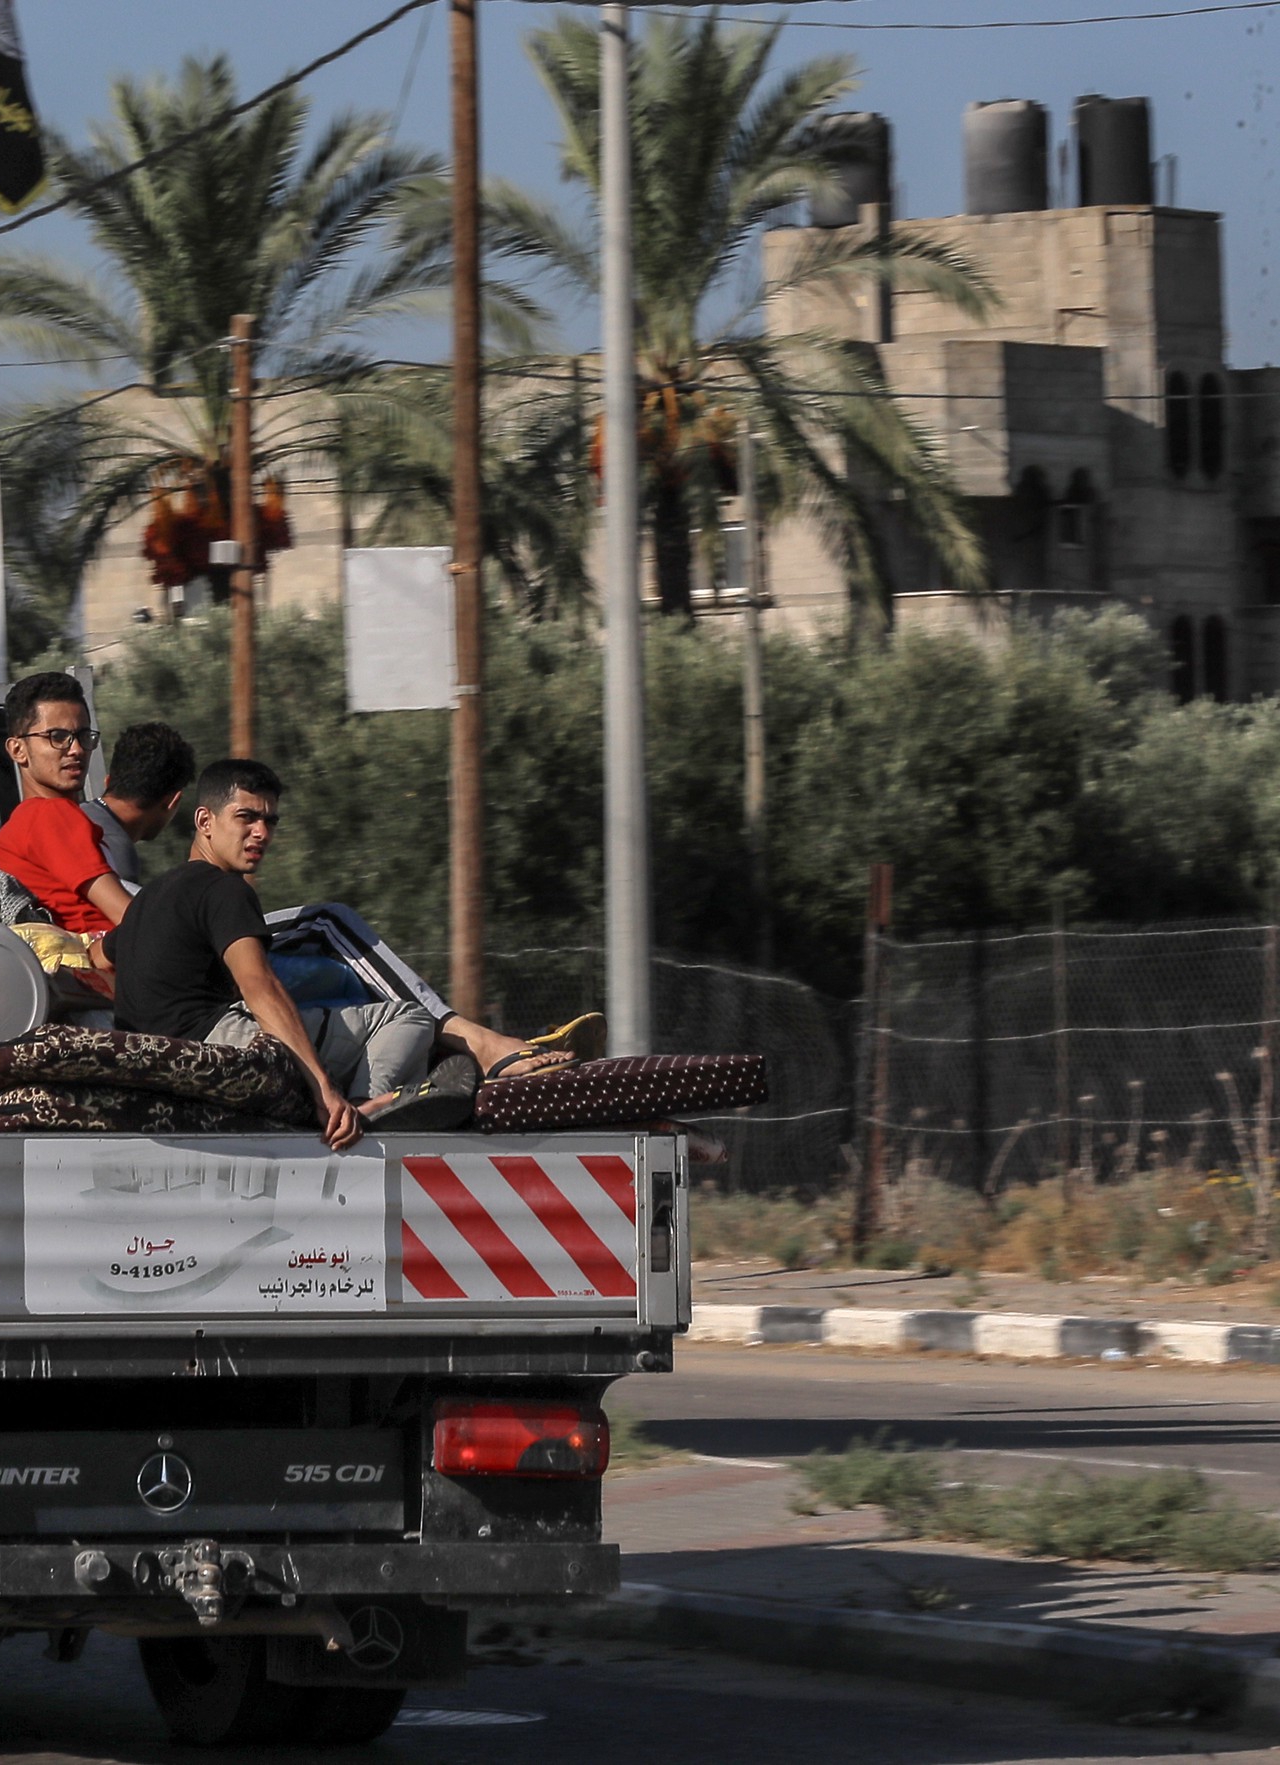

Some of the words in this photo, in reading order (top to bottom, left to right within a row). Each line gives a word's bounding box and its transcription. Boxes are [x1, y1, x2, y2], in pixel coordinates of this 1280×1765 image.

[126, 1235, 176, 1258] جوال
[287, 1246, 328, 1269] غليون
[110, 1255, 198, 1279] 9-418073
[329, 1277, 375, 1299] للرخام
[284, 1463, 332, 1483] 515
